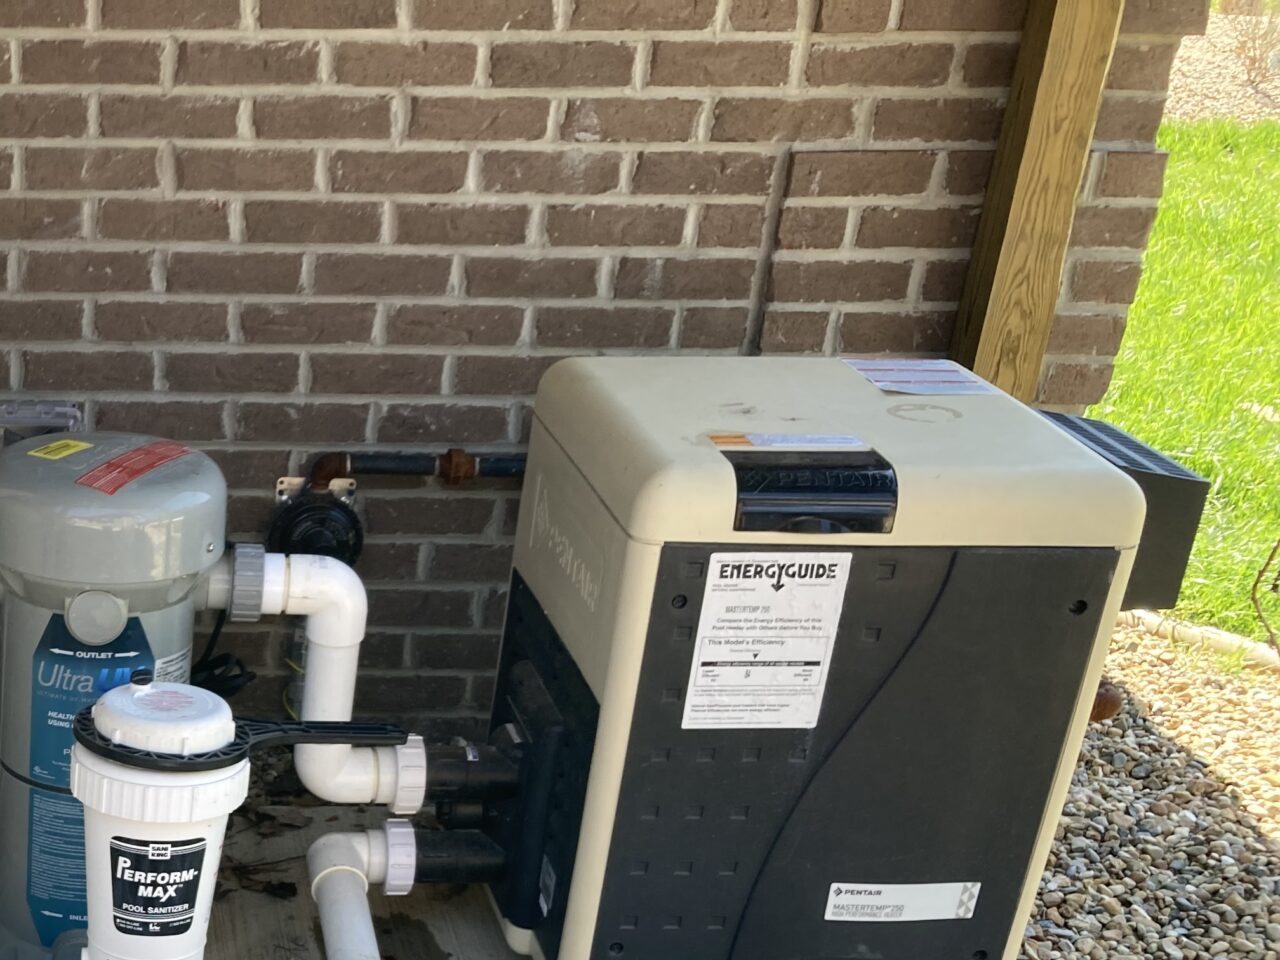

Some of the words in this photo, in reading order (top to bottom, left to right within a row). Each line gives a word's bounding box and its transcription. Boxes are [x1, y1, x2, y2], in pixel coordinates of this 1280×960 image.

[776, 471, 893, 488] PENTAIR
[719, 562, 839, 581] ENERGYGUIDE
[751, 639, 785, 647] Efficiency
[76, 650, 114, 659] OUTLET
[38, 661, 94, 692] Ultra
[48, 710, 76, 721] HEALTH
[48, 718, 70, 729] USING
[116, 855, 199, 885] PERFORM-
[122, 902, 146, 913] POOL
[147, 903, 190, 914] SANITIZER
[69, 914, 88, 922] INLE
